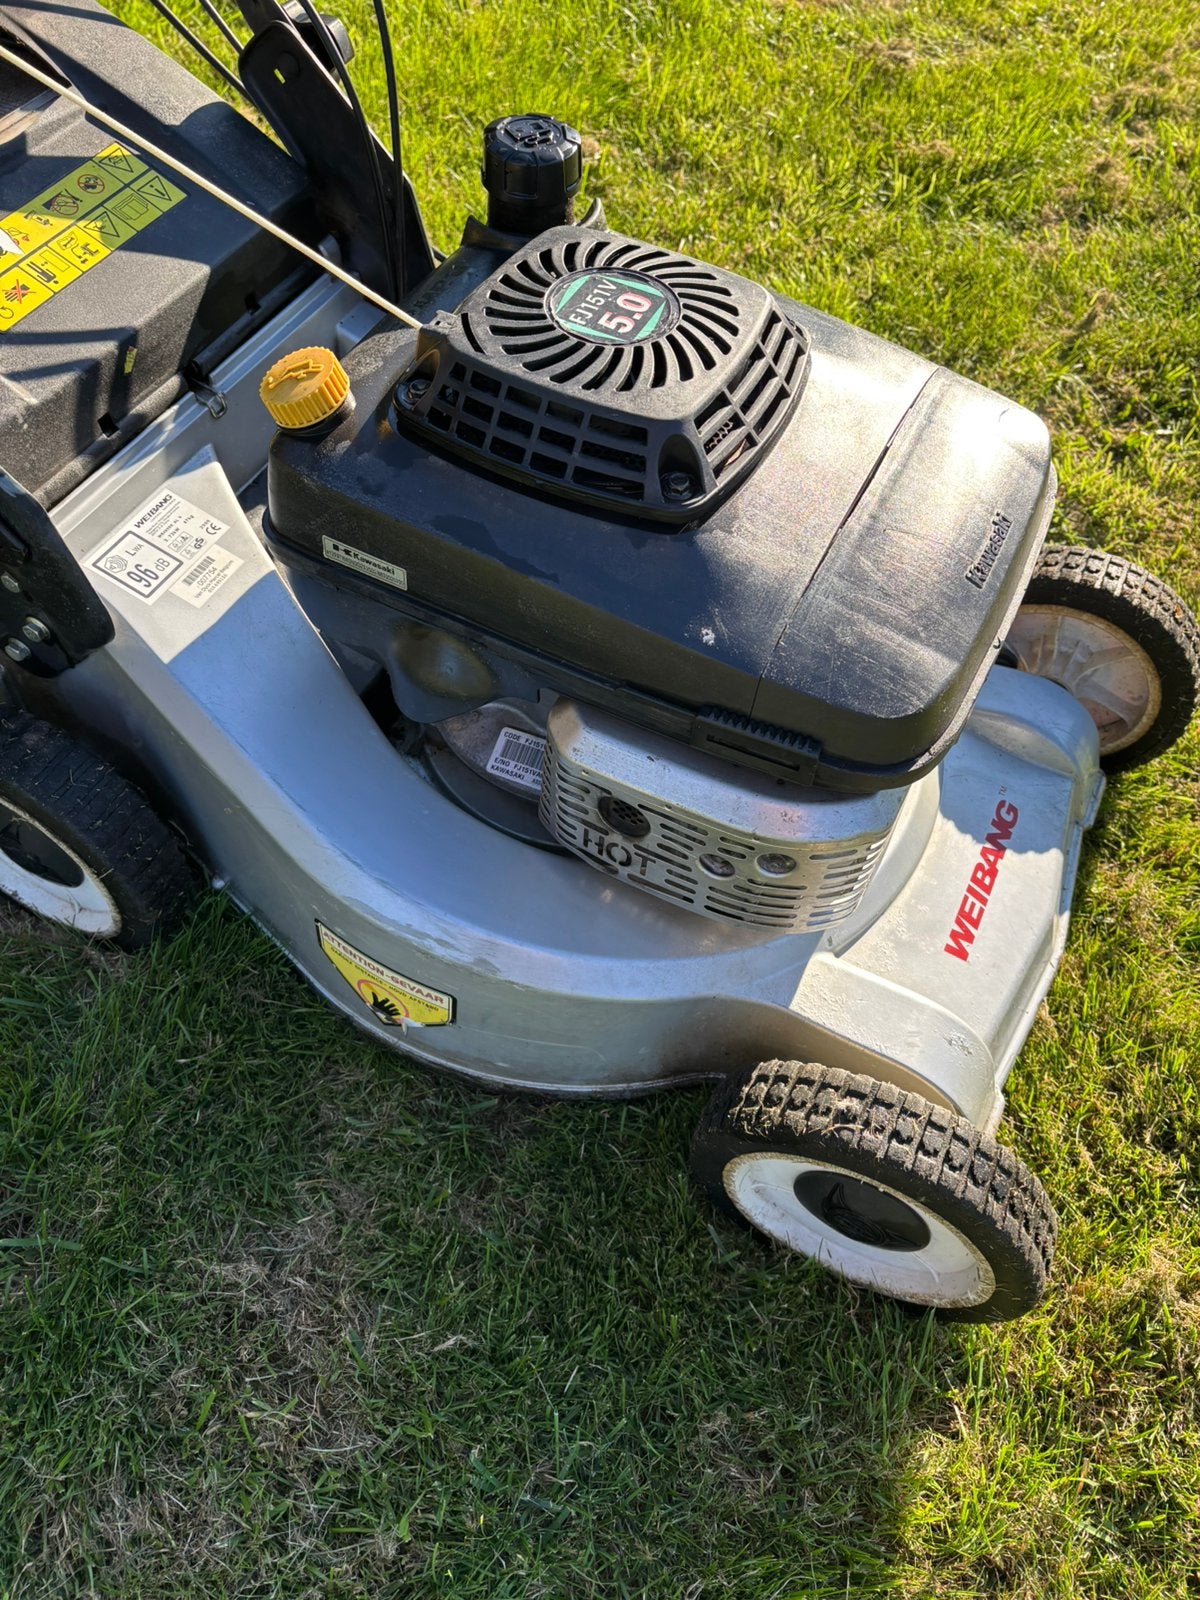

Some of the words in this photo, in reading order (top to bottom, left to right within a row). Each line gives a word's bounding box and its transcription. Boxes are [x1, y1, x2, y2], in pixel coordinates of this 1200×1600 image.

[569, 279, 617, 325] FJ151V
[598, 291, 652, 334] 5.0
[134, 493, 173, 528] WEIBANG
[353, 552, 395, 575] Kawasaki
[964, 510, 1012, 589] Kawasaki
[127, 563, 159, 588] 96
[155, 557, 171, 572] dB
[504, 731, 521, 741] CODE
[490, 764, 525, 780] KAWASAKI
[494, 757, 510, 767] E/NO
[582, 828, 657, 876] HOT
[943, 800, 1019, 962] WEIBANG
